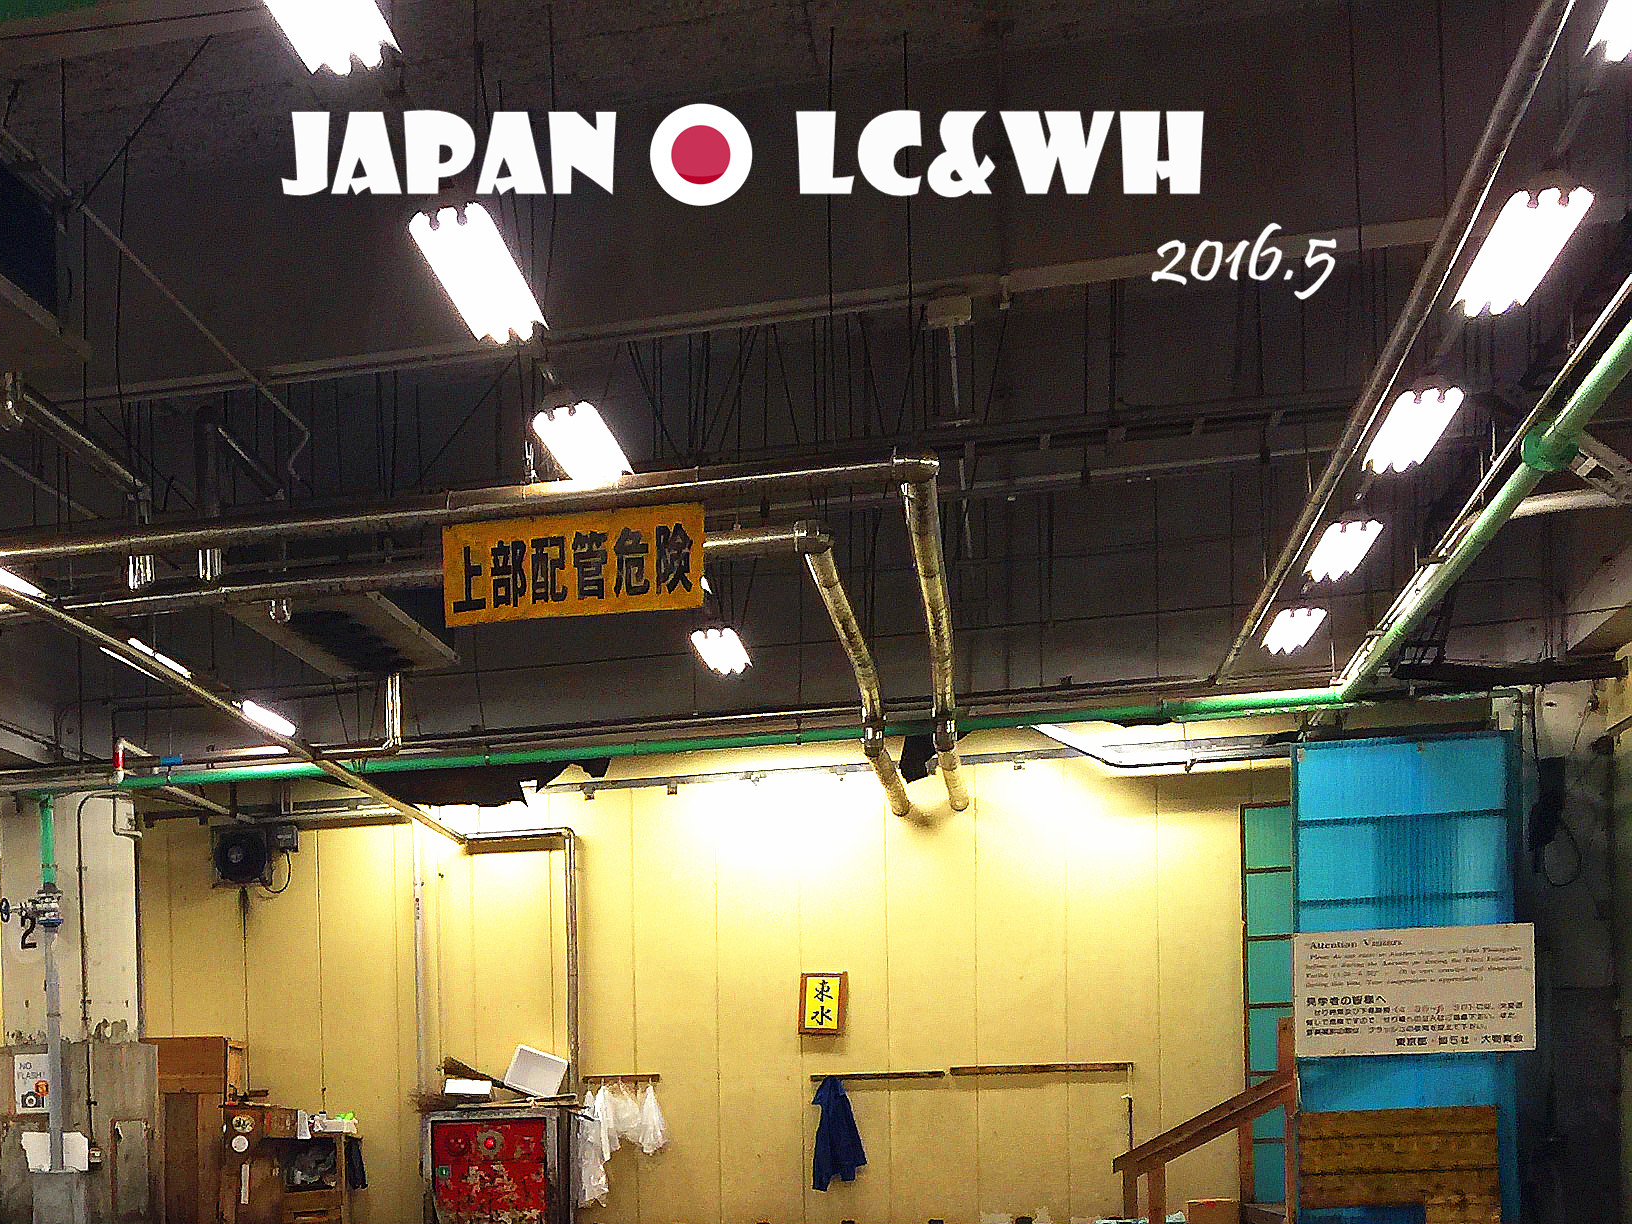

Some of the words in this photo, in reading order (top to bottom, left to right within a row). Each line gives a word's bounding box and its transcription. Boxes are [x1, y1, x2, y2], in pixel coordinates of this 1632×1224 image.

[452, 522, 694, 614] 上部配管危険
